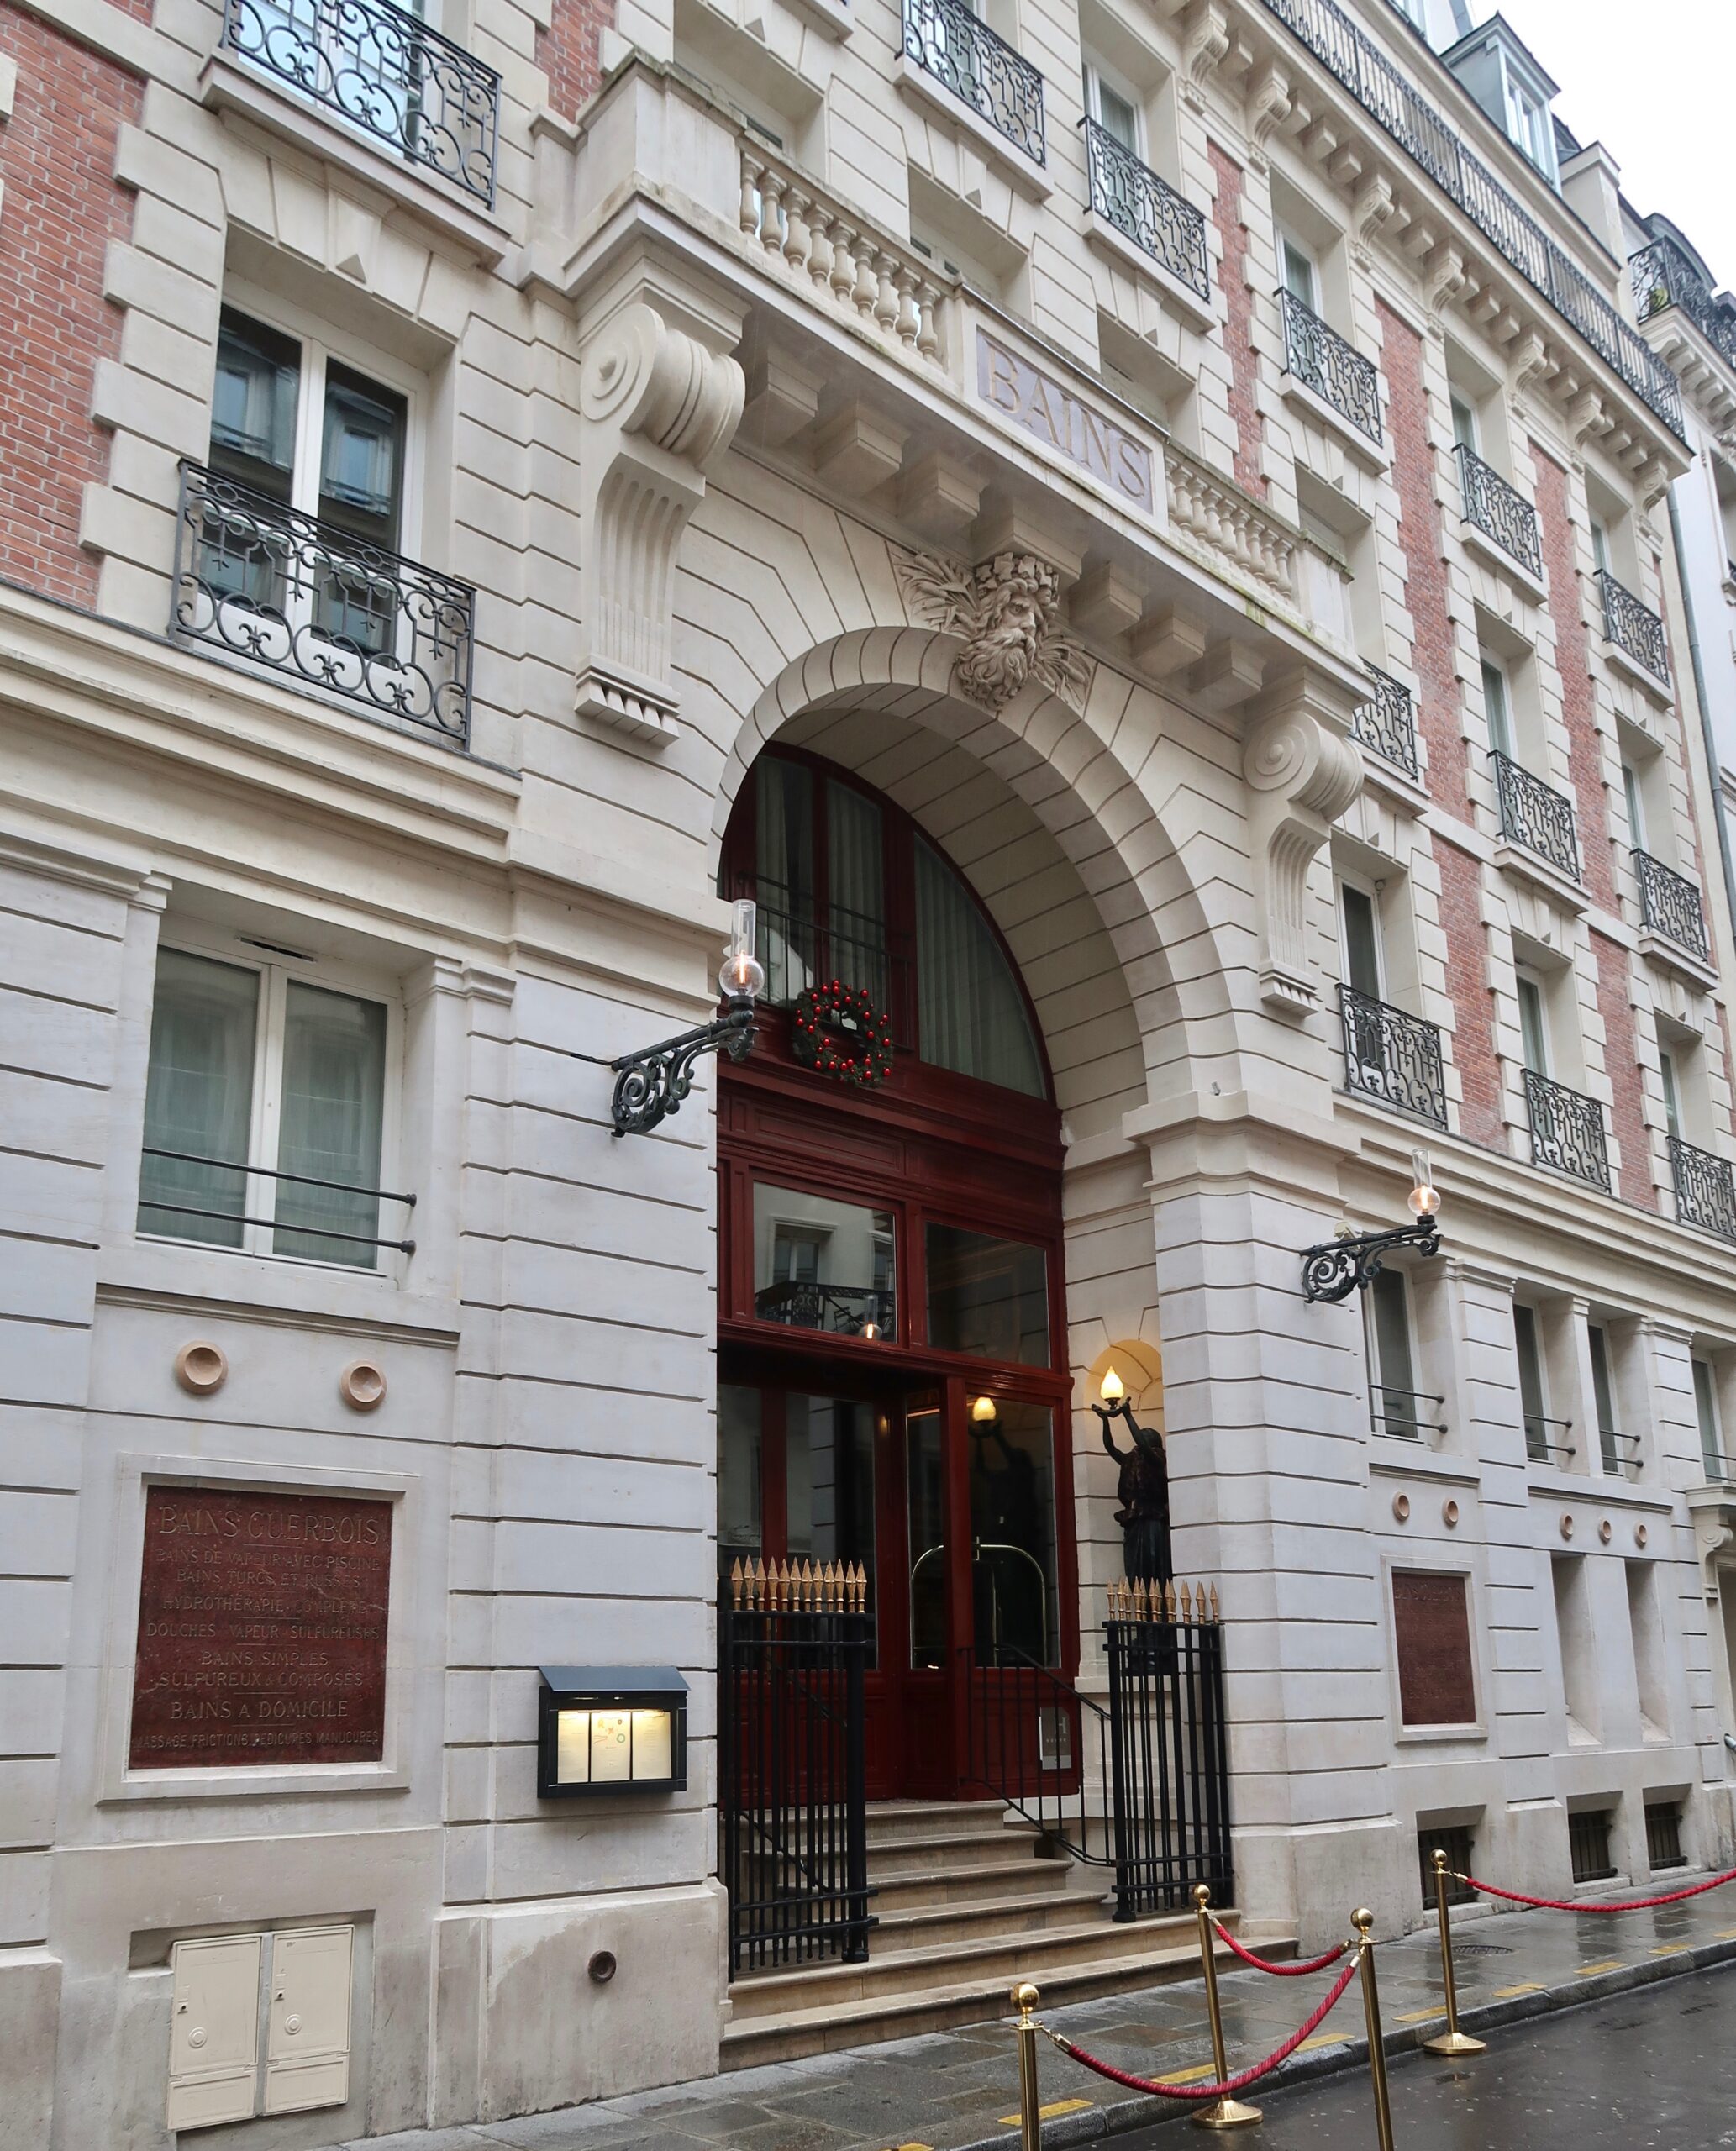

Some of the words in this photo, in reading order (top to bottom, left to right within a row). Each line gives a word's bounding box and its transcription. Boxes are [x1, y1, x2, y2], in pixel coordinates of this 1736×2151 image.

[983, 338, 1145, 498] BAINS
[158, 1507, 242, 1538] BAINS
[247, 1512, 379, 1544] GUERBOIS
[155, 1548, 198, 1564] BAINS
[203, 1549, 223, 1565] DE
[228, 1553, 281, 1568] VAPEUR
[285, 1554, 323, 1569] AVEC
[326, 1555, 382, 1571] PISCINE
[176, 1568, 220, 1583] BAINS
[227, 1570, 274, 1585] TURCS
[281, 1573, 302, 1586] ET
[305, 1573, 360, 1588] RUSSES
[147, 1622, 216, 1638] DOUCHES
[229, 1624, 279, 1639] VAPEUR
[290, 1625, 380, 1640] SULFUREUSES
[201, 1650, 254, 1665] BAINS
[261, 1650, 329, 1666] SIMPLES
[159, 1672, 261, 1686] SULFUREUX
[265, 1673, 273, 1686] &
[170, 1701, 232, 1719] BAINS
[238, 1703, 252, 1718] A
[259, 1700, 348, 1718] DOMICILE
[192, 1733, 249, 1747] FRICTIONS
